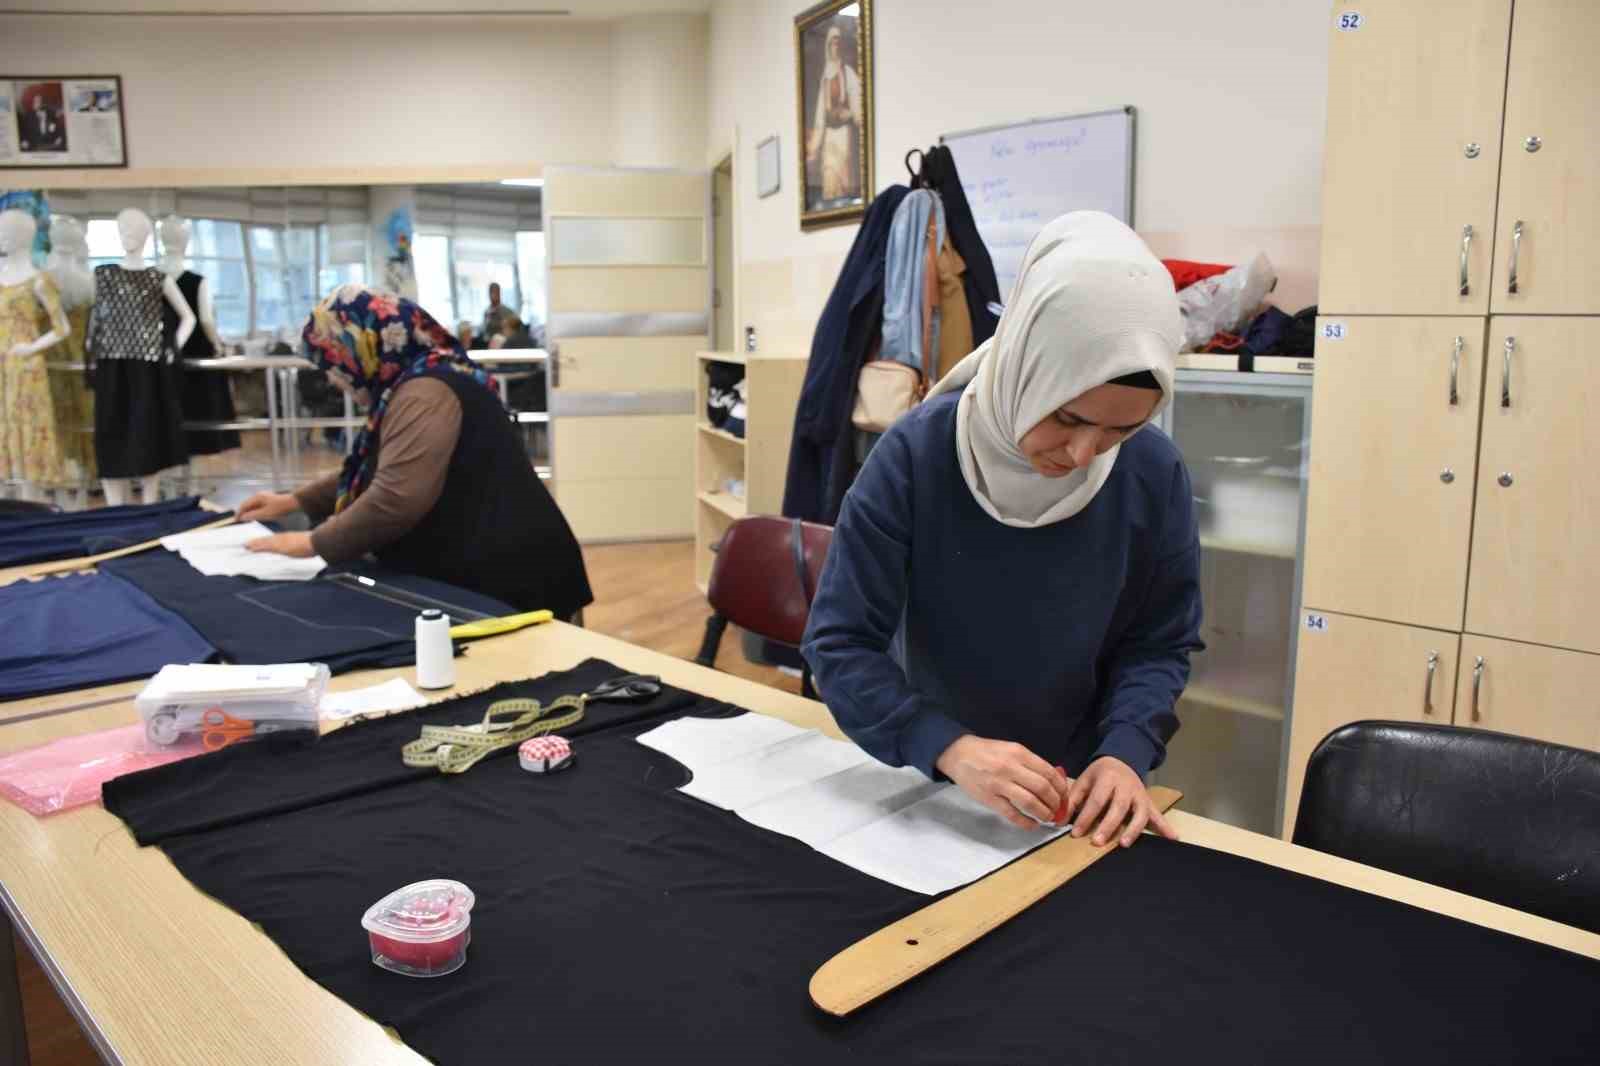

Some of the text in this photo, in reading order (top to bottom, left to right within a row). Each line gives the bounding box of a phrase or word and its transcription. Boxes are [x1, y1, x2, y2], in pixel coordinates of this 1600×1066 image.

[1341, 14, 1359, 28] 52
[1326, 324, 1341, 338] 53
[1308, 615, 1323, 629] 54
